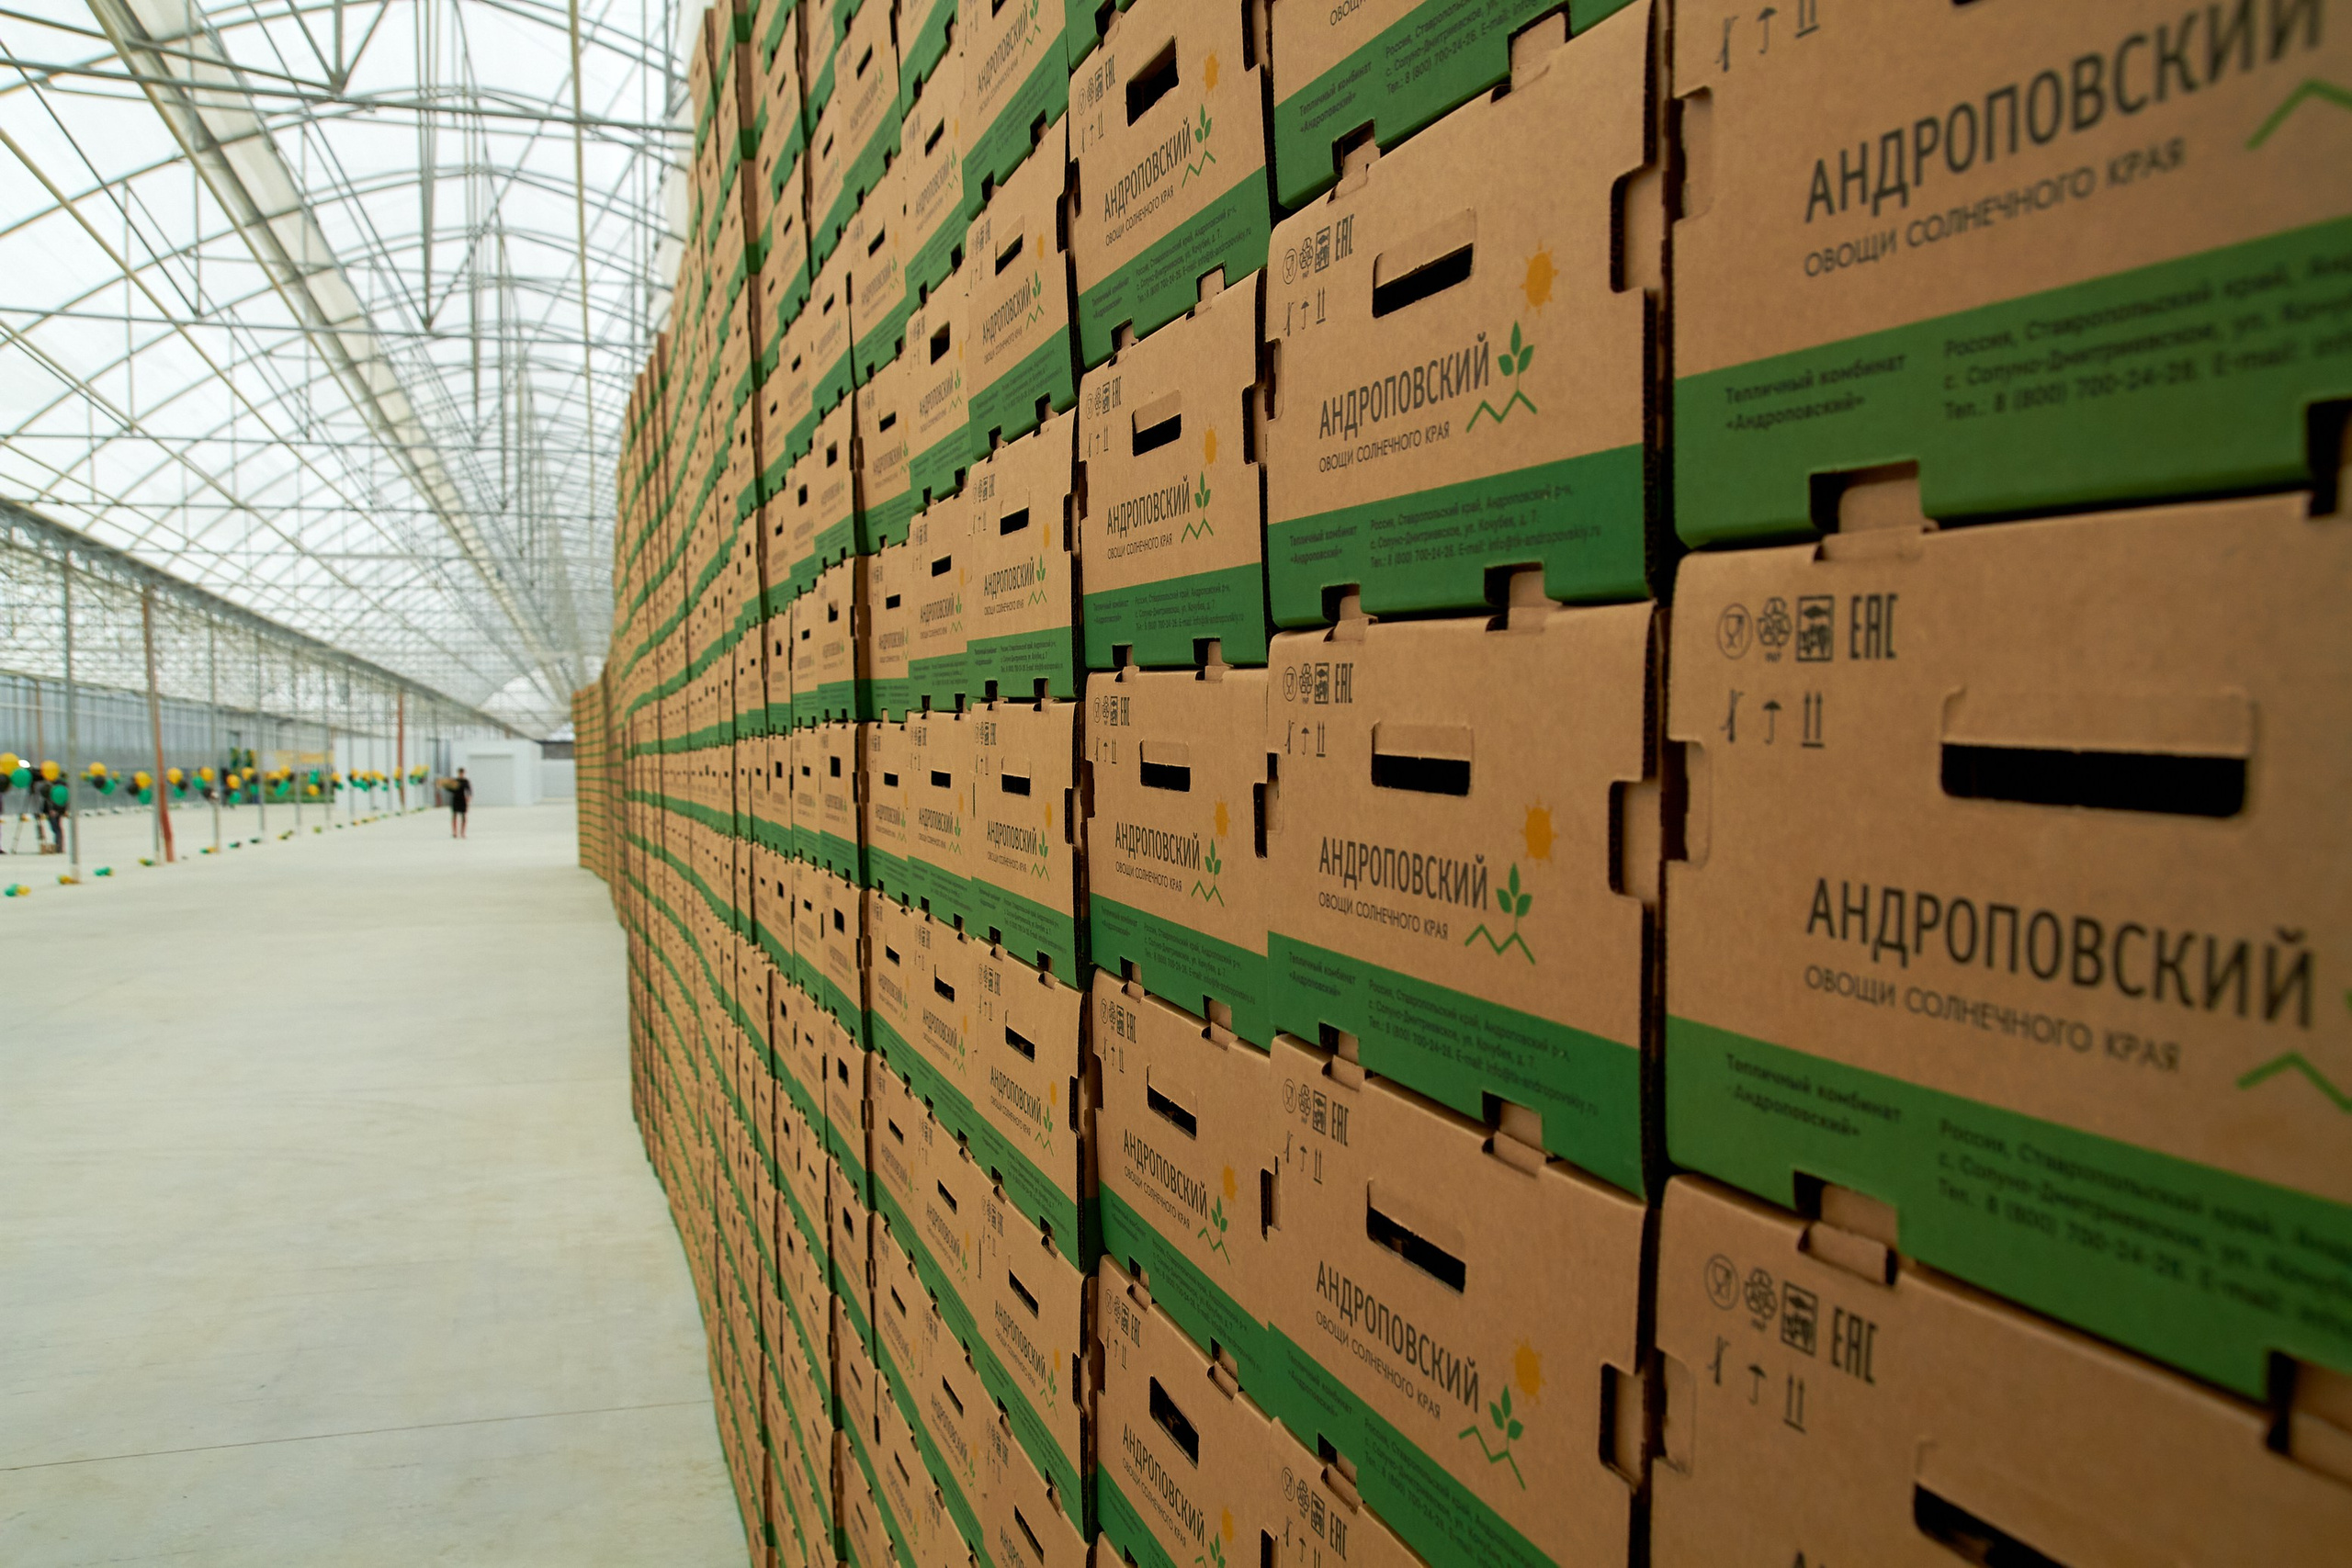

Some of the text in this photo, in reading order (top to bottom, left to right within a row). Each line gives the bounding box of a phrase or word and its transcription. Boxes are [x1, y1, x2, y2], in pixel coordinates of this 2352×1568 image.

[1330, 0, 1367, 25] ОВОЩ
[1103, 117, 1191, 222] АНДРОПОВСКИЙ
[1804, 135, 2186, 280] ОВОЩИ СОЛНЕЧНОГО КРАЯ
[982, 276, 1031, 345] АНДРОПОВСКИЙ
[1319, 333, 1488, 440] АНДРОПОВСКИЙ
[1319, 420, 1449, 473] ОВОЩИ СОЛНЕЧНОГО КРАЯ
[1106, 476, 1190, 537] АНДРОПОВСКИЙ
[984, 557, 1035, 600] АНДРОПОВСКИЙ
[987, 820, 1037, 855] АНДРОПОВСКИЙ
[1114, 821, 1200, 870] АНДРОПОВСКИЙ
[1319, 837, 1487, 910] АНДРОПОВСКИЙ
[1318, 891, 1447, 940] ОВОЩИ СОЛНЕЧНОГО КРАЯ
[1806, 876, 2312, 1030] АНДРОПОВСКИЙ
[1804, 963, 2180, 1073] ОВОЩИ СОЛНЕЧНОГО КРАЯ
[989, 1066, 1042, 1126] АНДРОПОВСКИЙ
[1123, 1128, 1207, 1219] АНДРОПОВСКИЙ
[1317, 1258, 1479, 1414] АНДРОПОВСКИЙ
[1317, 1308, 1440, 1421] ОВОЩИ СОЛНЕЧНОГО КРАЯ
[1123, 1420, 1204, 1549] АНДРОПОВСКИЙ
